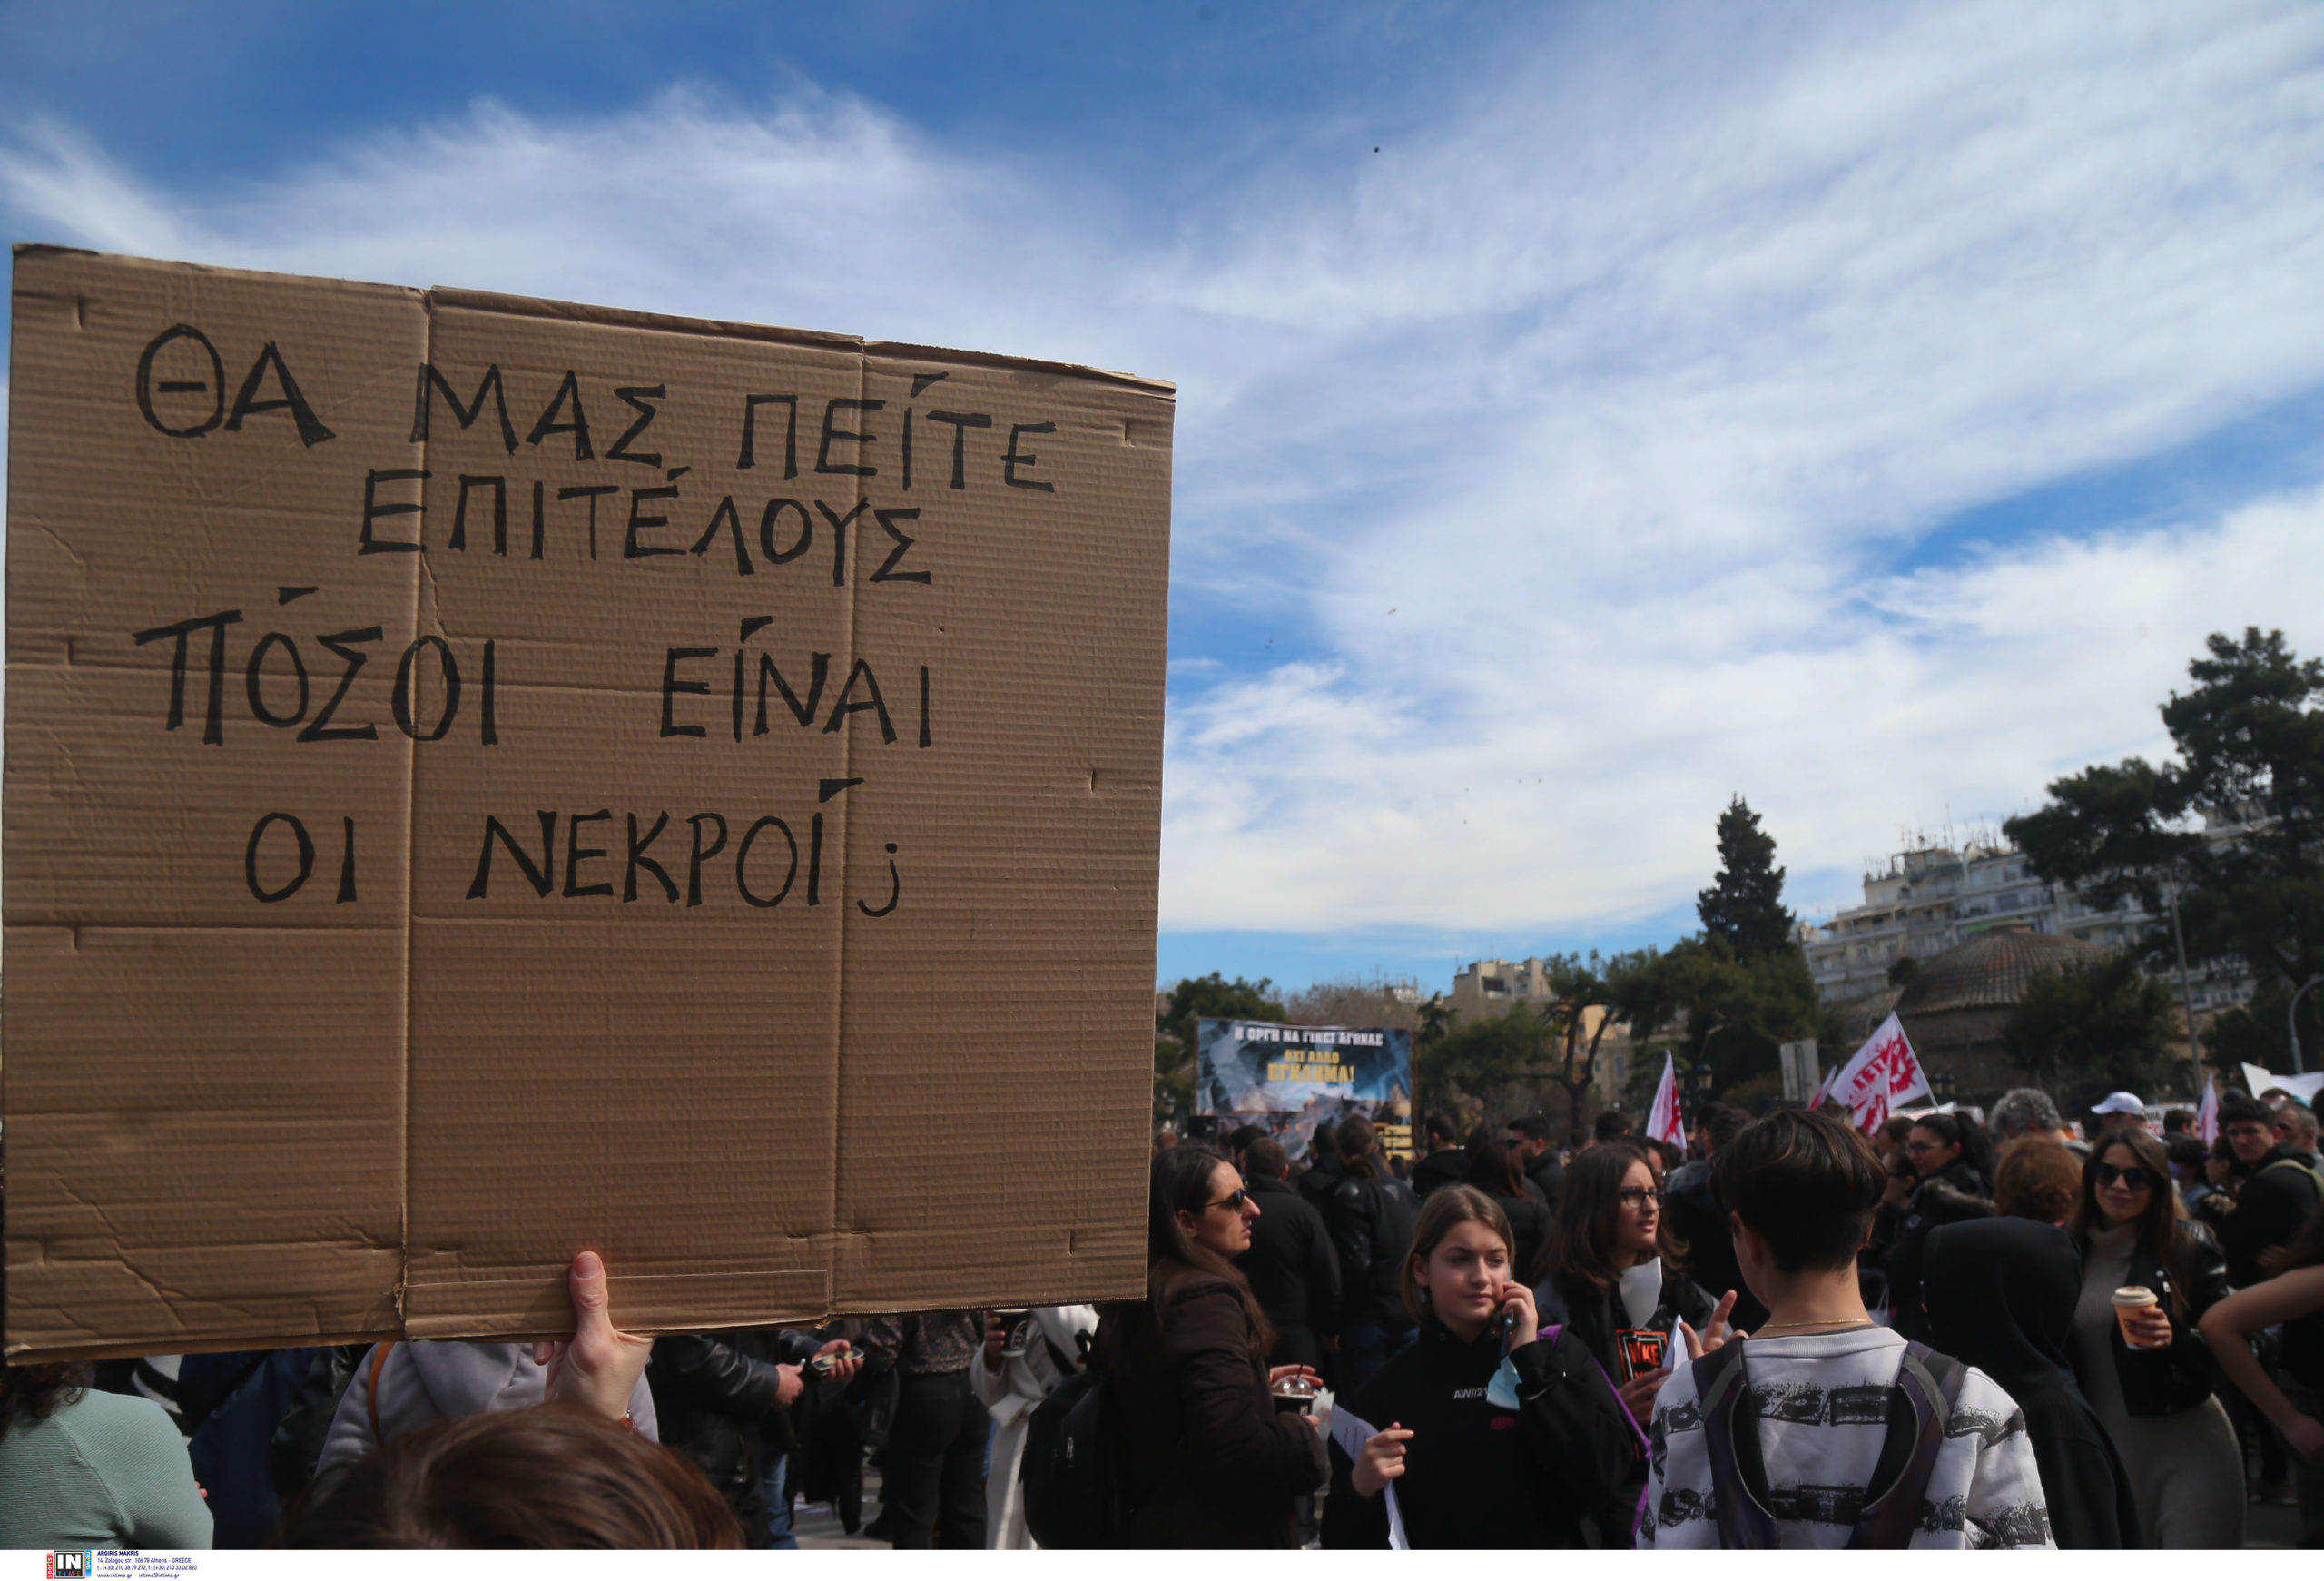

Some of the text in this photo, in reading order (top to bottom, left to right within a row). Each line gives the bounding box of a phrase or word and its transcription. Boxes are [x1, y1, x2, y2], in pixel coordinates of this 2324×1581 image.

[136, 323, 1057, 493] ΘΑ ΜΑΣ ΠΕΊΤΕ
[358, 466, 932, 587] ΕΠΙΤΈΛΟΥΣ
[133, 586, 931, 748] ΠΌΣΟΙ ΕΊΝΑΙ
[245, 812, 357, 904] ΟΙ
[1247, 1027, 1281, 1042] ΟΡΓΗ
[1283, 1029, 1300, 1042] ΝΑ
[1284, 1049, 1340, 1064] ΟΧΙ ΑΛΛΟ
